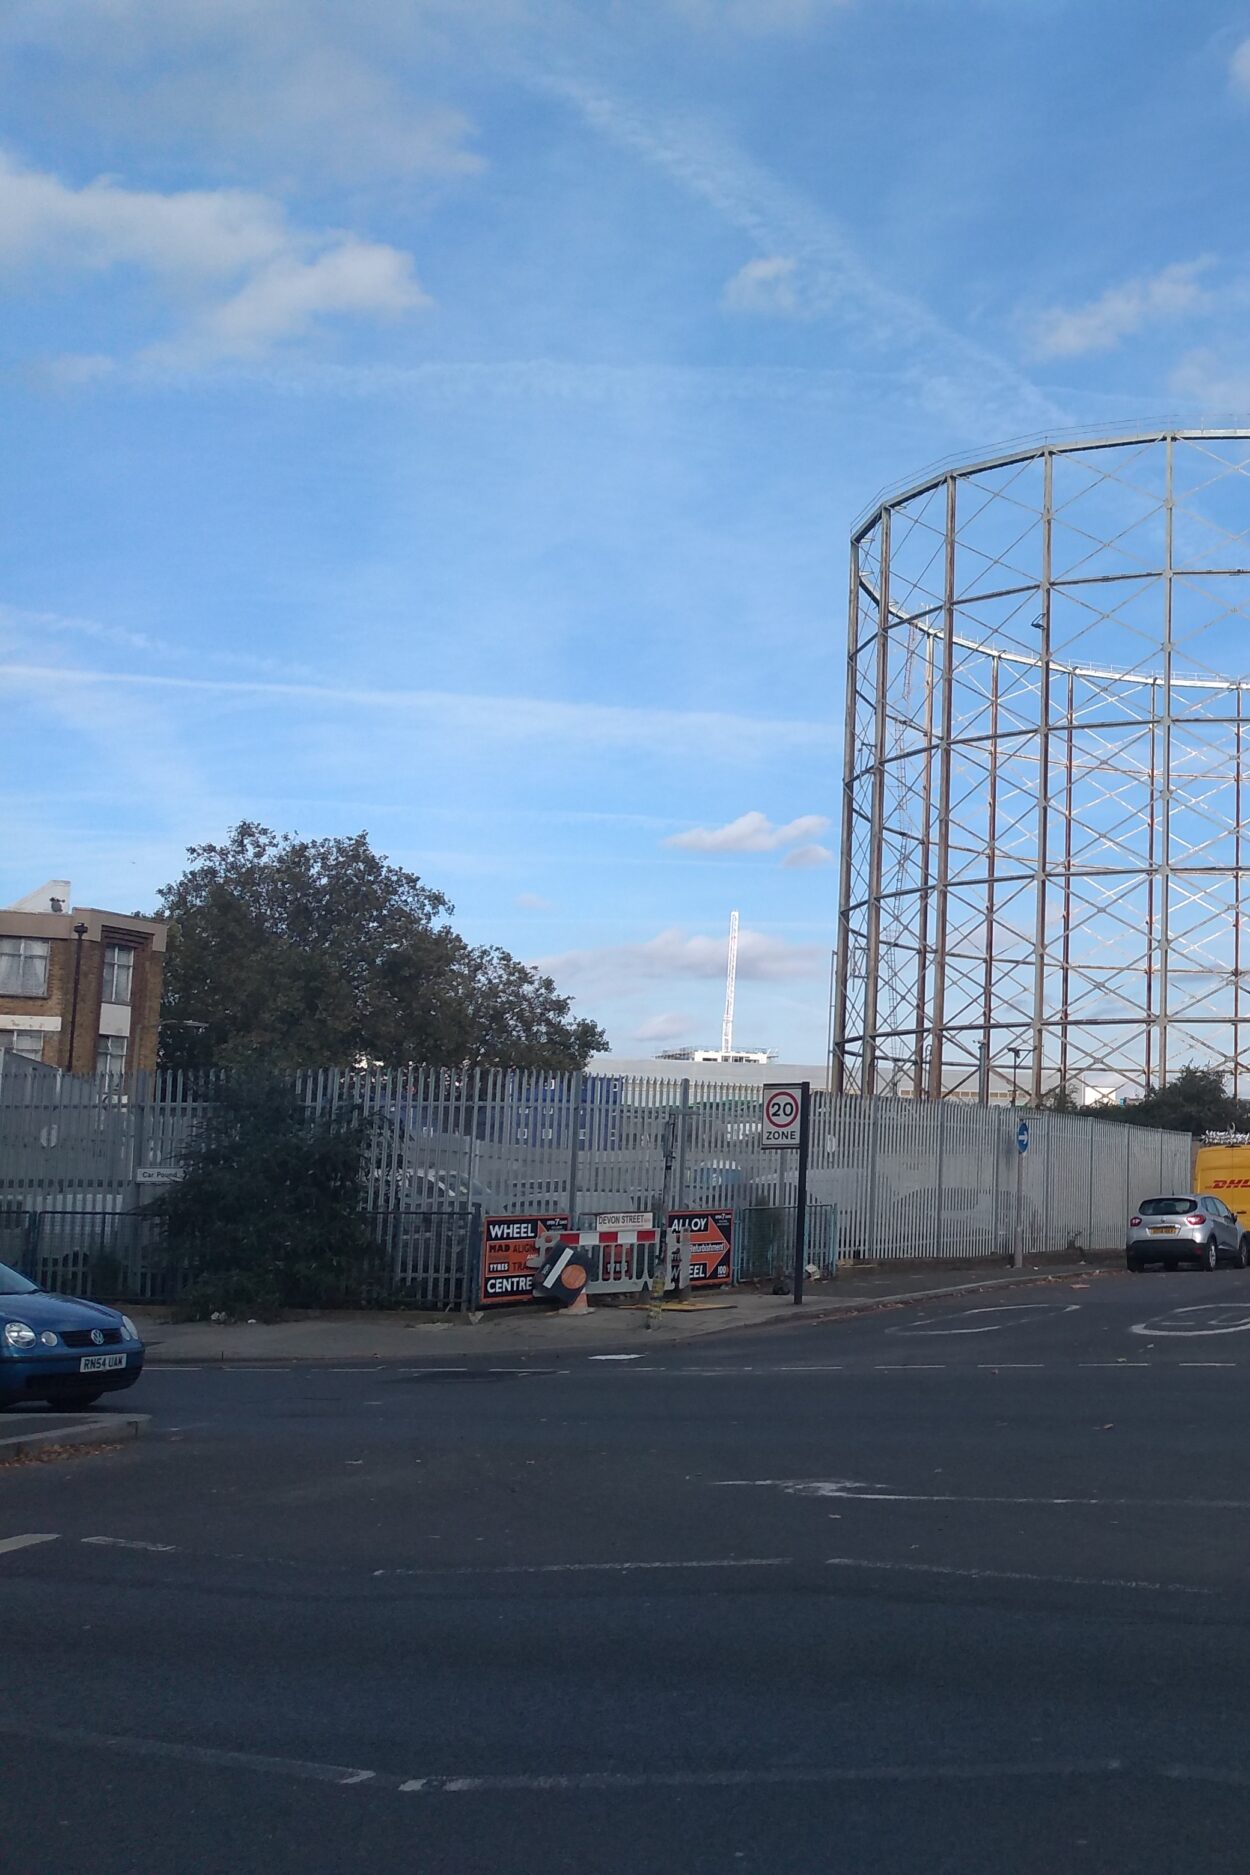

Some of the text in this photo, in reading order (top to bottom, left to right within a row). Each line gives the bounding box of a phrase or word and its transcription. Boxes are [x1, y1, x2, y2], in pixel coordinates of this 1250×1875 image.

[771, 1102, 794, 1117] 20
[766, 1131, 796, 1140] ZONE
[598, 1215, 620, 1225] DEVON
[621, 1214, 644, 1224] STREET
[671, 1218, 707, 1231] ALLOY
[489, 1223, 535, 1239] WHEEL
[489, 1244, 510, 1253] MAD
[489, 1263, 509, 1272] TYRES
[671, 1265, 705, 1279] WEEL
[487, 1277, 533, 1293] CENTRE
